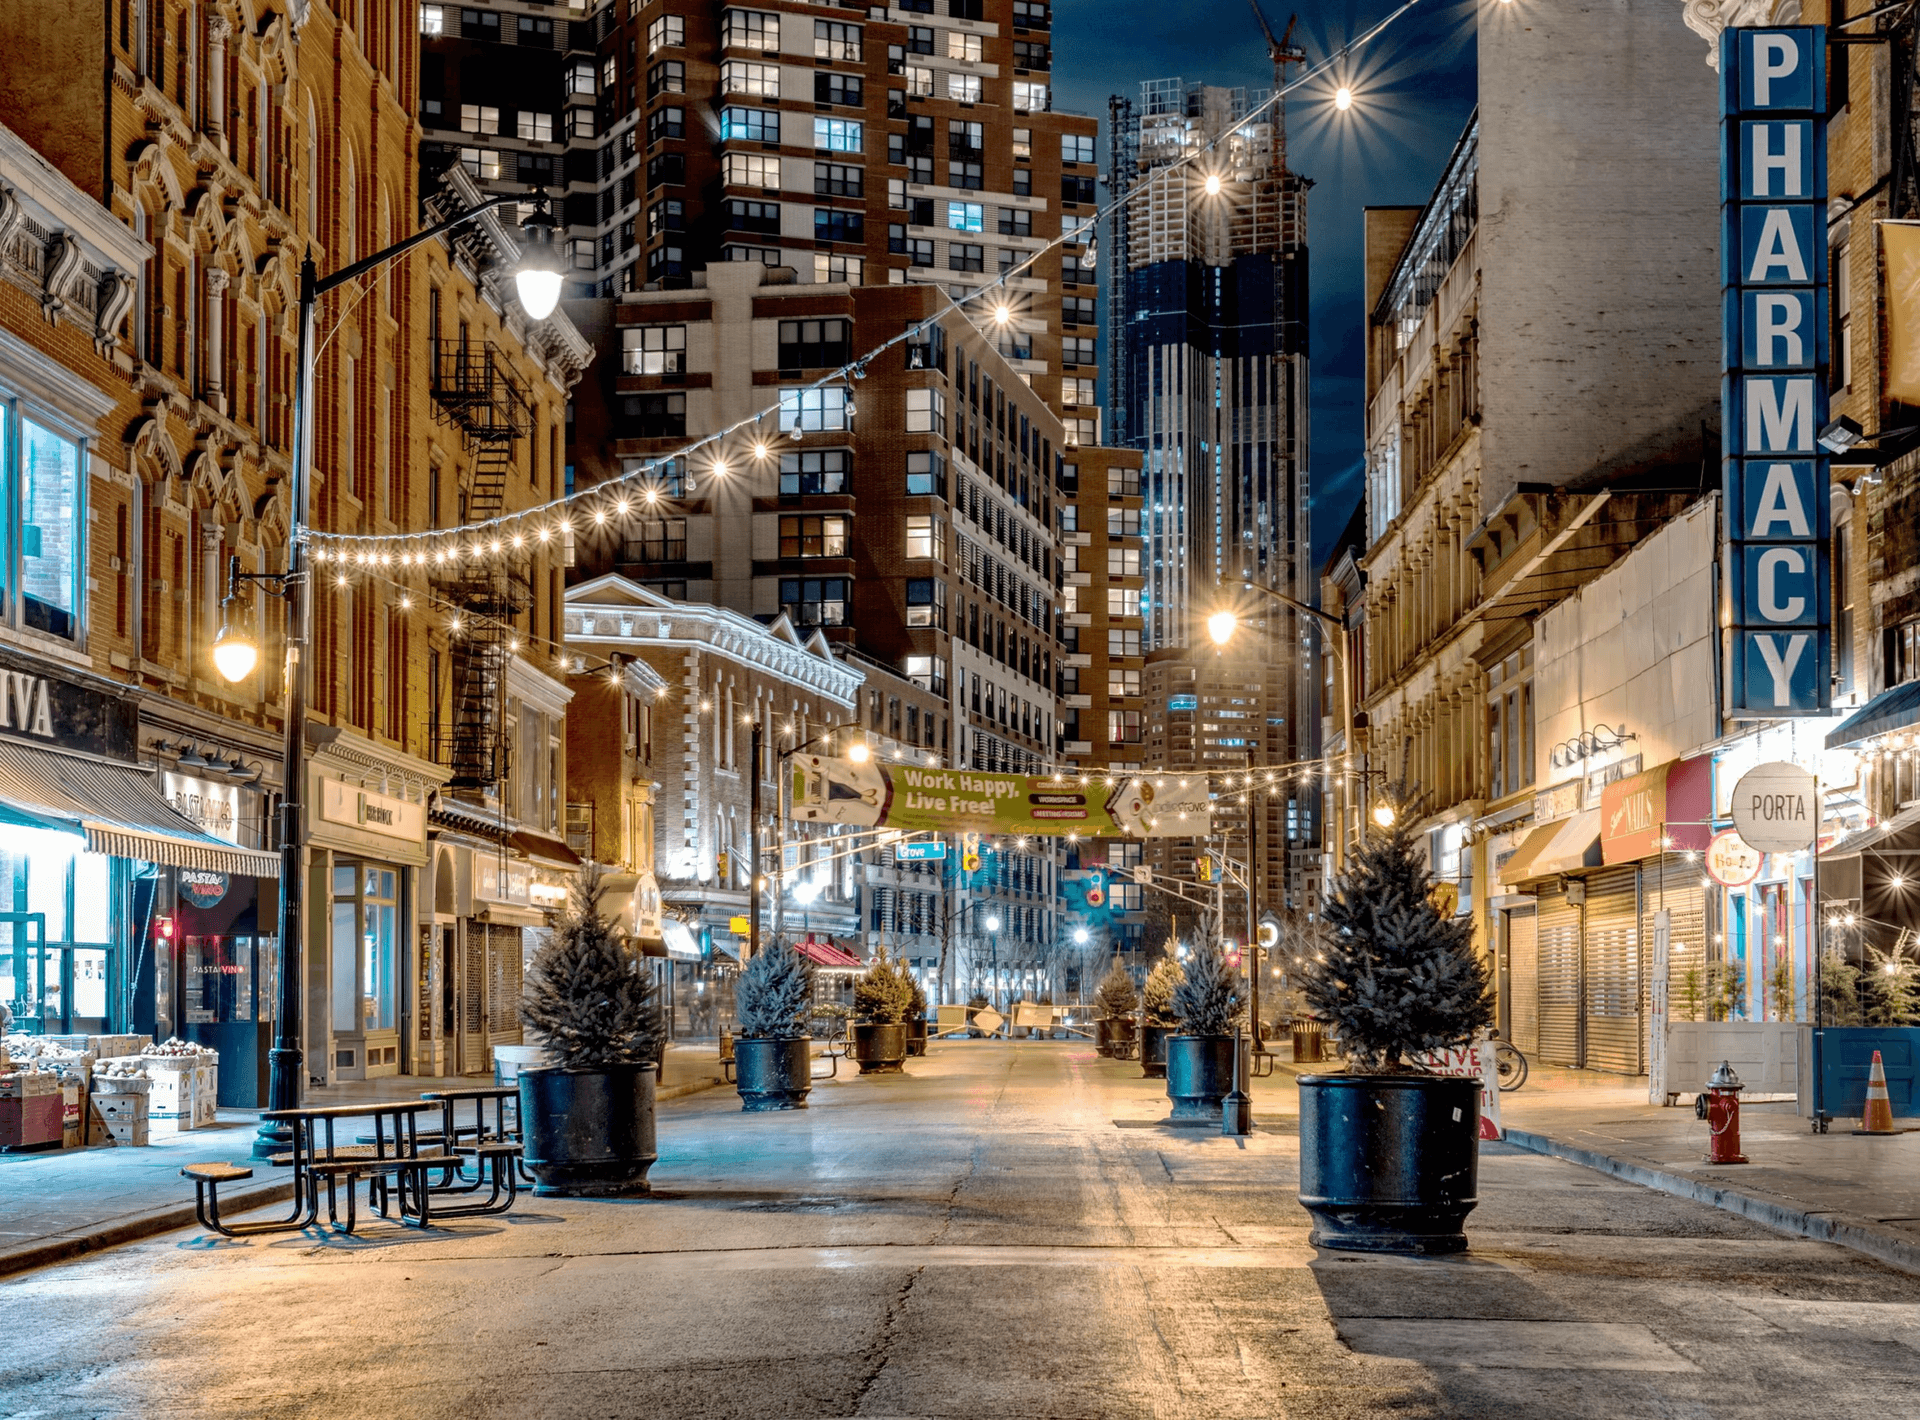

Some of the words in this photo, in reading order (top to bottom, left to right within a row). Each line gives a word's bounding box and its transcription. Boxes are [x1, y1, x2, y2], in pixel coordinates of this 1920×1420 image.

[1746, 33, 1814, 707] PHARMACY
[904, 770, 956, 790] Work
[960, 775, 1020, 798] Happy,
[905, 792, 947, 811] Live
[951, 796, 996, 815] Free!
[1037, 796, 1077, 804] WORKSPACE
[1752, 794, 1806, 821] PORTA
[1624, 789, 1653, 834] NAILS
[900, 846, 925, 857] Grove
[182, 871, 219, 884] PASTA
[192, 883, 223, 896] VINO
[192, 965, 218, 973] PASTA
[221, 965, 245, 974] VINO
[1429, 1048, 1481, 1067] LIVE
